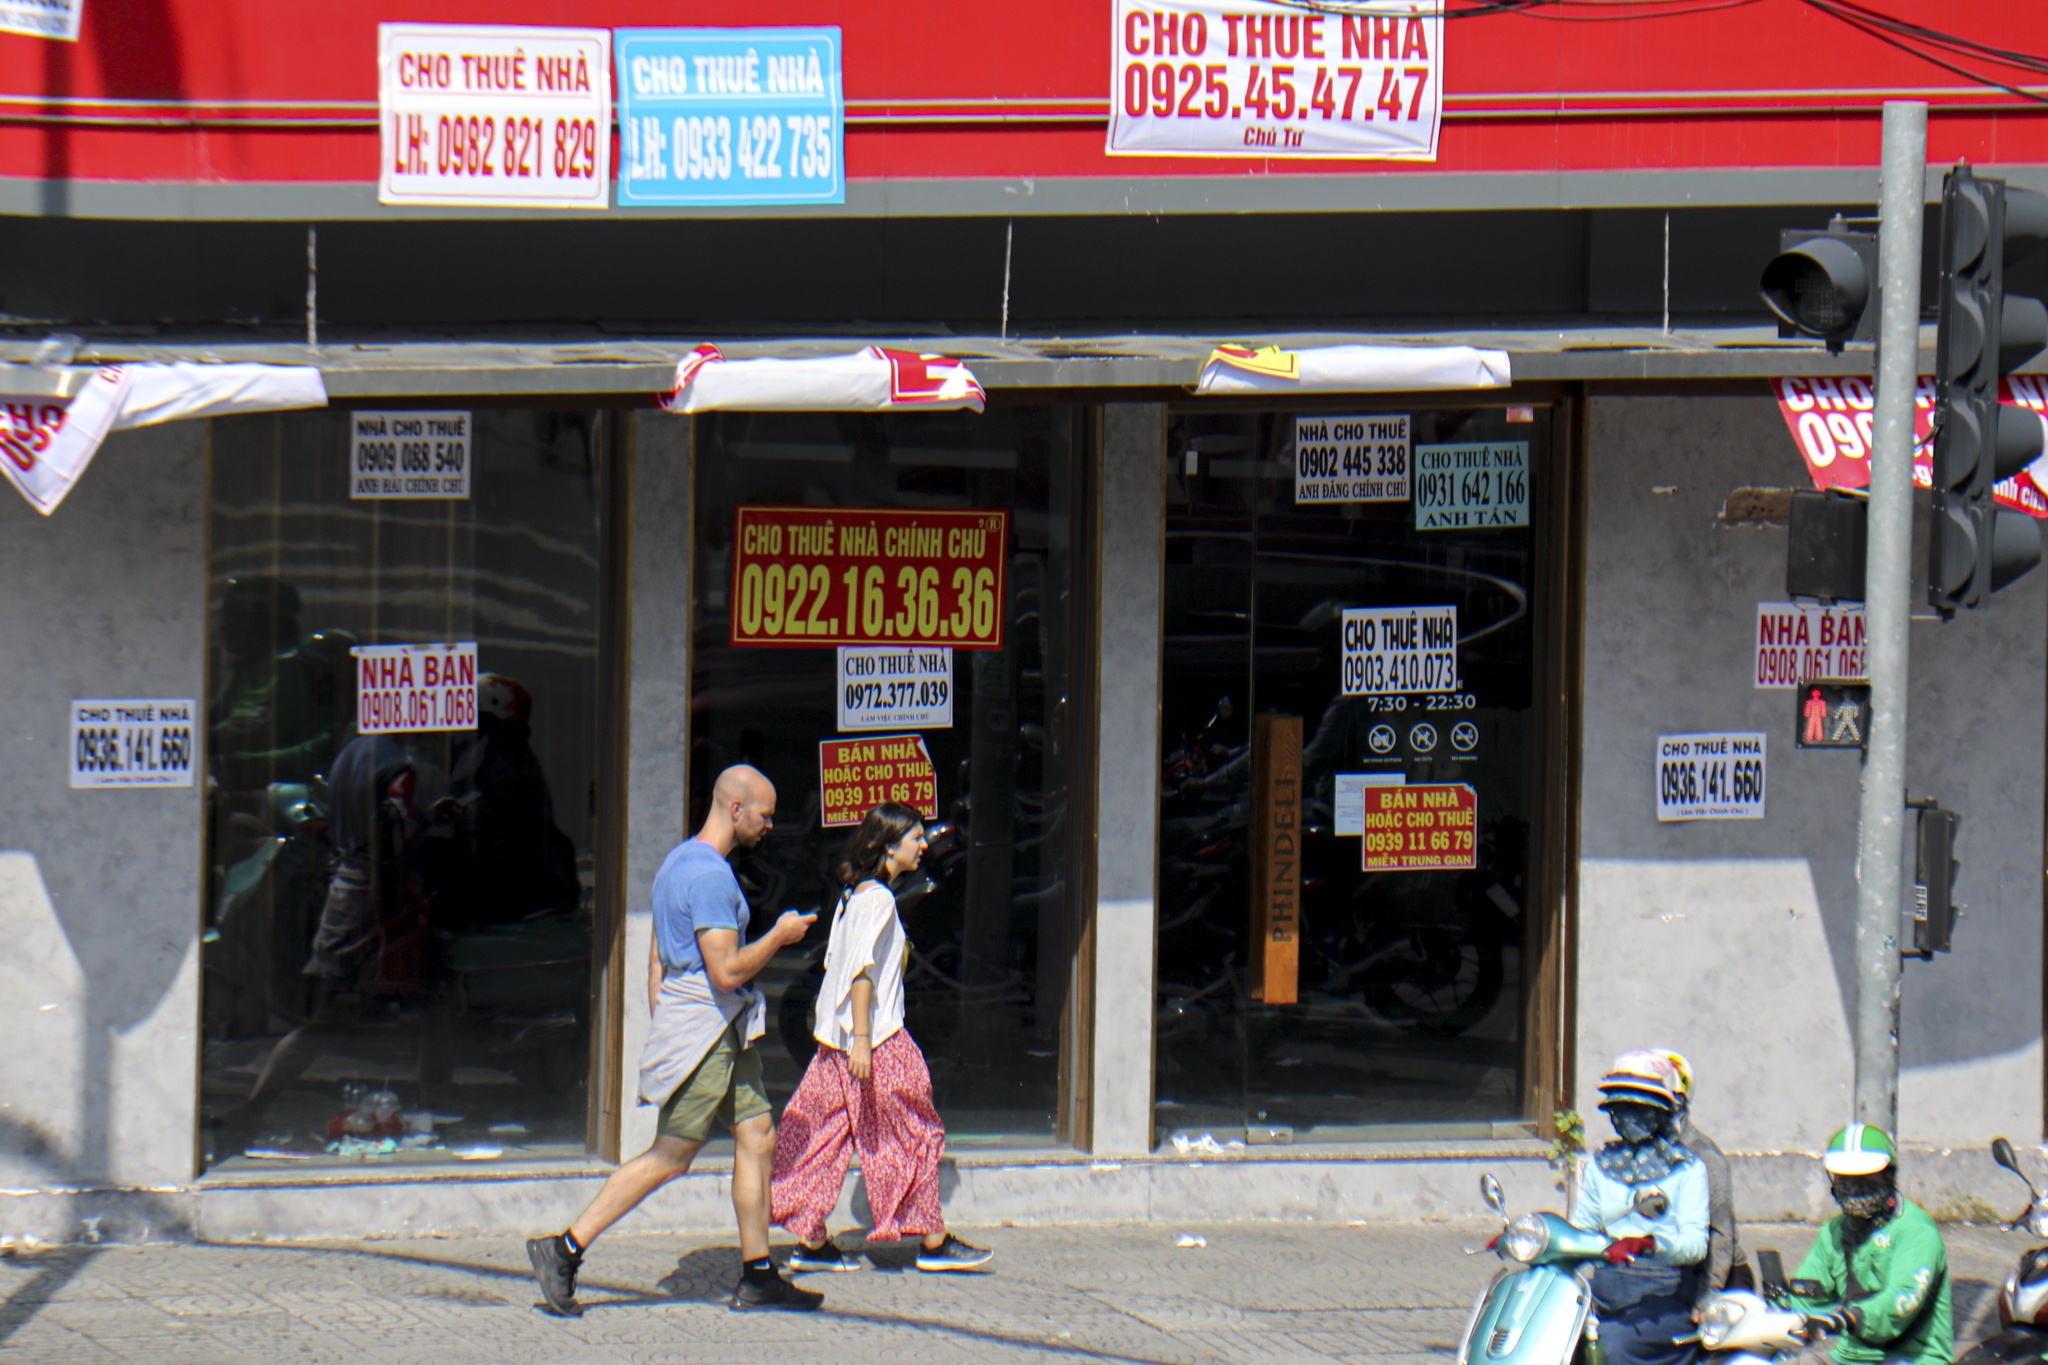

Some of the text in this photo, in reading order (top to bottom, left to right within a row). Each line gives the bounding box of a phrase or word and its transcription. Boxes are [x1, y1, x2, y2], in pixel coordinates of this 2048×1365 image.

[1125, 9, 1208, 56] CHO
[1342, 3, 1429, 60] NHÀ
[400, 47, 591, 92] CHO THUÊ NHÀ
[632, 47, 825, 94] CHO THUÊ NHÀ
[1125, 62, 1429, 122] 0925.45.47.47
[394, 112, 596, 179] LH: 0982 821 829
[630, 115, 831, 181] LH: 0933 422 735
[358, 415, 466, 436] NHÀ CHO THUÊ
[1299, 418, 1406, 441] NHÀ CHO THUÊ
[1300, 444, 1406, 478] 0902 445 338
[1421, 445, 1522, 469] CHO THUÊ NHÀ
[1299, 484, 1319, 499] ANH
[1352, 479, 1383, 497] CHÍNH
[1418, 470, 1525, 507] 0931 642 166
[1424, 511, 1468, 527] ANH
[744, 524, 783, 555] CHO
[788, 519, 835, 556] THUÊ
[840, 521, 879, 557] NHÀ
[885, 521, 943, 558] CHÍNH
[948, 519, 987, 559] CHỦ
[741, 563, 995, 638] 0922.16.36.36
[1345, 609, 1453, 652] CHO THUÊ NHÀ
[363, 648, 414, 689] NHÀ
[845, 648, 948, 676] CHO THUÊ NHÀ
[1345, 653, 1453, 692] 0903.410.073
[362, 687, 475, 729] 0908.061.068
[845, 680, 949, 710] 0972.377.039
[1368, 695, 1407, 712] 7:30
[1426, 694, 1476, 711] 22:30
[79, 707, 110, 722] CHO
[115, 703, 154, 722] THUÊ
[838, 739, 918, 764] BÁN NHÀ
[1662, 737, 1761, 757] CHO THUÊ NHÀ
[824, 764, 861, 787] HOẶC
[865, 764, 893, 780] CHO
[1662, 760, 1763, 806] 0936.141.660
[825, 781, 933, 808] 0939 11 66 79
[1381, 788, 1459, 809] BÁN NHÀ
[1366, 810, 1403, 832] HOẶC
[1407, 811, 1434, 828] CHO
[1438, 807, 1474, 827] THUÊ
[1366, 831, 1473, 852] 0939 11 66 79
[1272, 777, 1295, 943] PHINDELI
[1401, 856, 1441, 866] TRUNG
[1444, 855, 1472, 865] GIAN
